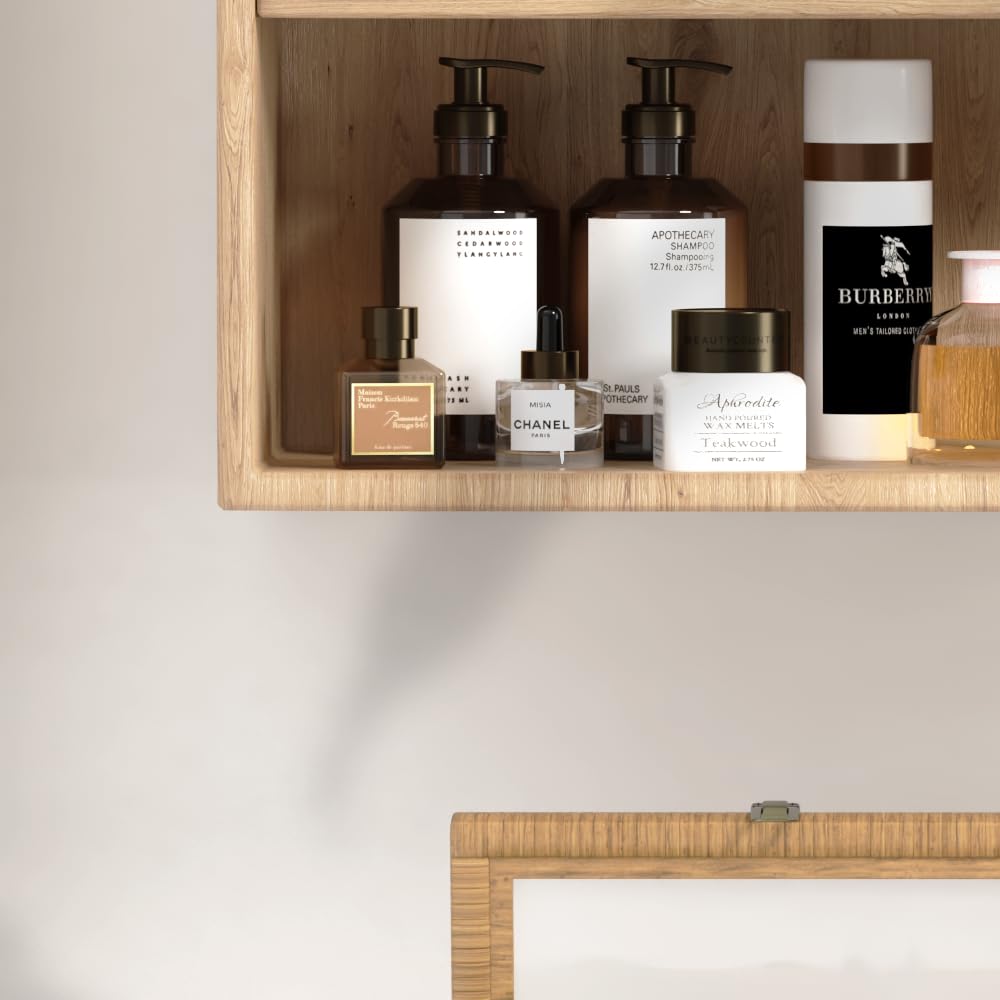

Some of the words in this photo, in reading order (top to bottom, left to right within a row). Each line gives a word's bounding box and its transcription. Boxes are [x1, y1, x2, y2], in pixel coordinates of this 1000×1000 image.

[652, 229, 714, 240] APOTHECARY
[670, 242, 715, 251] SHAMPOO
[665, 252, 714, 262] Shampooing
[838, 287, 932, 304] BURBERRY
[853, 326, 874, 335] MEN'S
[876, 327, 902, 335] TAILORED
[614, 384, 640, 393] PAULS
[696, 392, 782, 413] Aphrodite
[514, 419, 570, 431] CHANEL
[703, 422, 732, 430] WAX
[736, 422, 775, 430] MELTS
[701, 437, 777, 448] Teakwood
